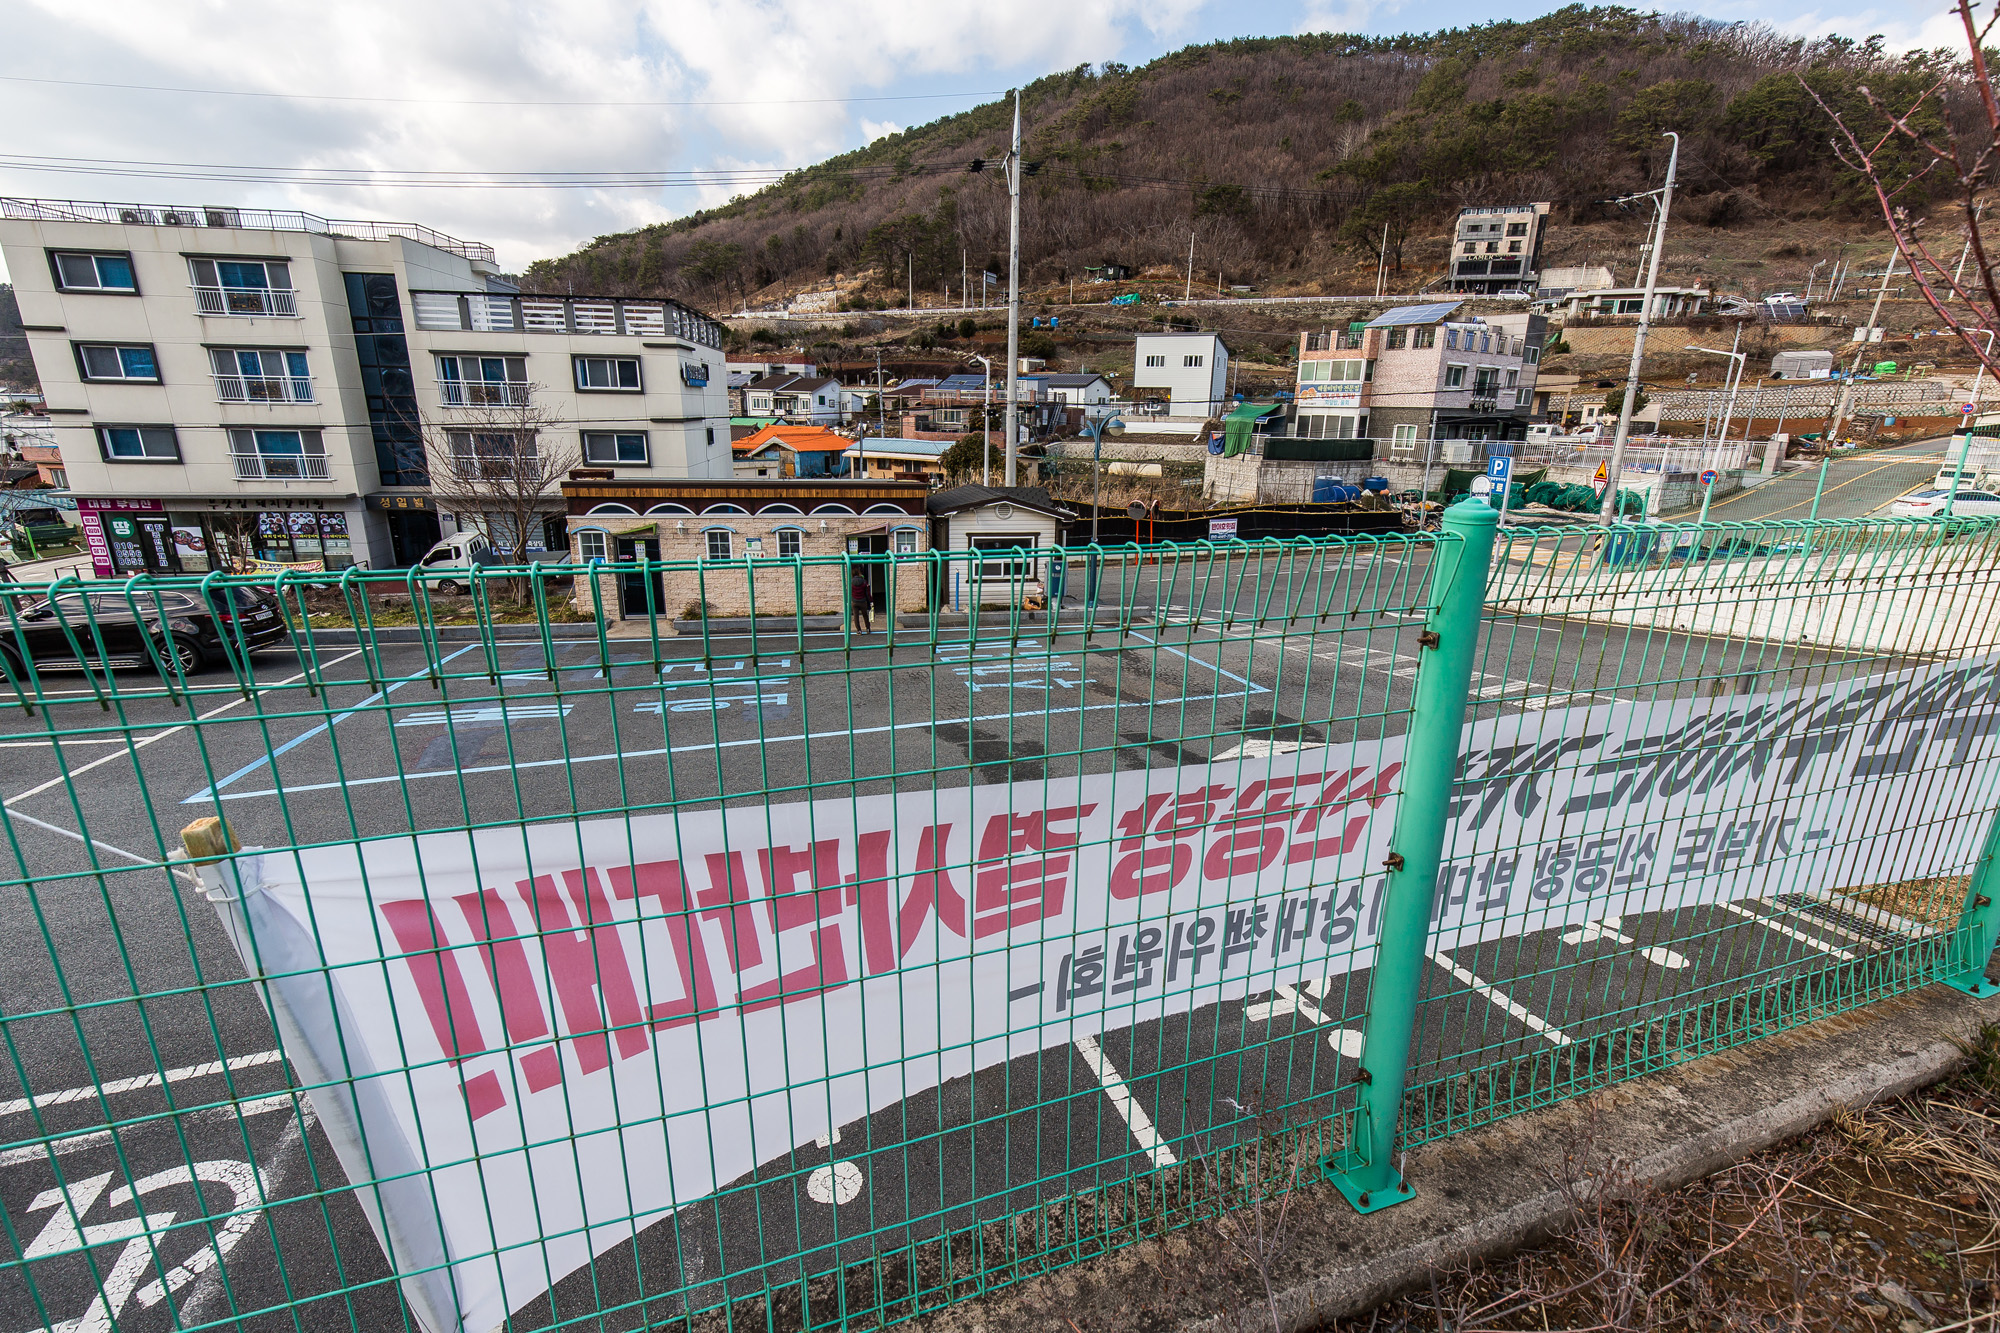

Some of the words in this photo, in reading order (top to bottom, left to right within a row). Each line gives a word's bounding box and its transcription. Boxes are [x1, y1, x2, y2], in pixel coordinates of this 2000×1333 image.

[1495, 461, 1504, 475] P
[116, 499, 152, 508] 부동산
[112, 521, 130, 535] 땅
[113, 541, 140, 550] 010-
